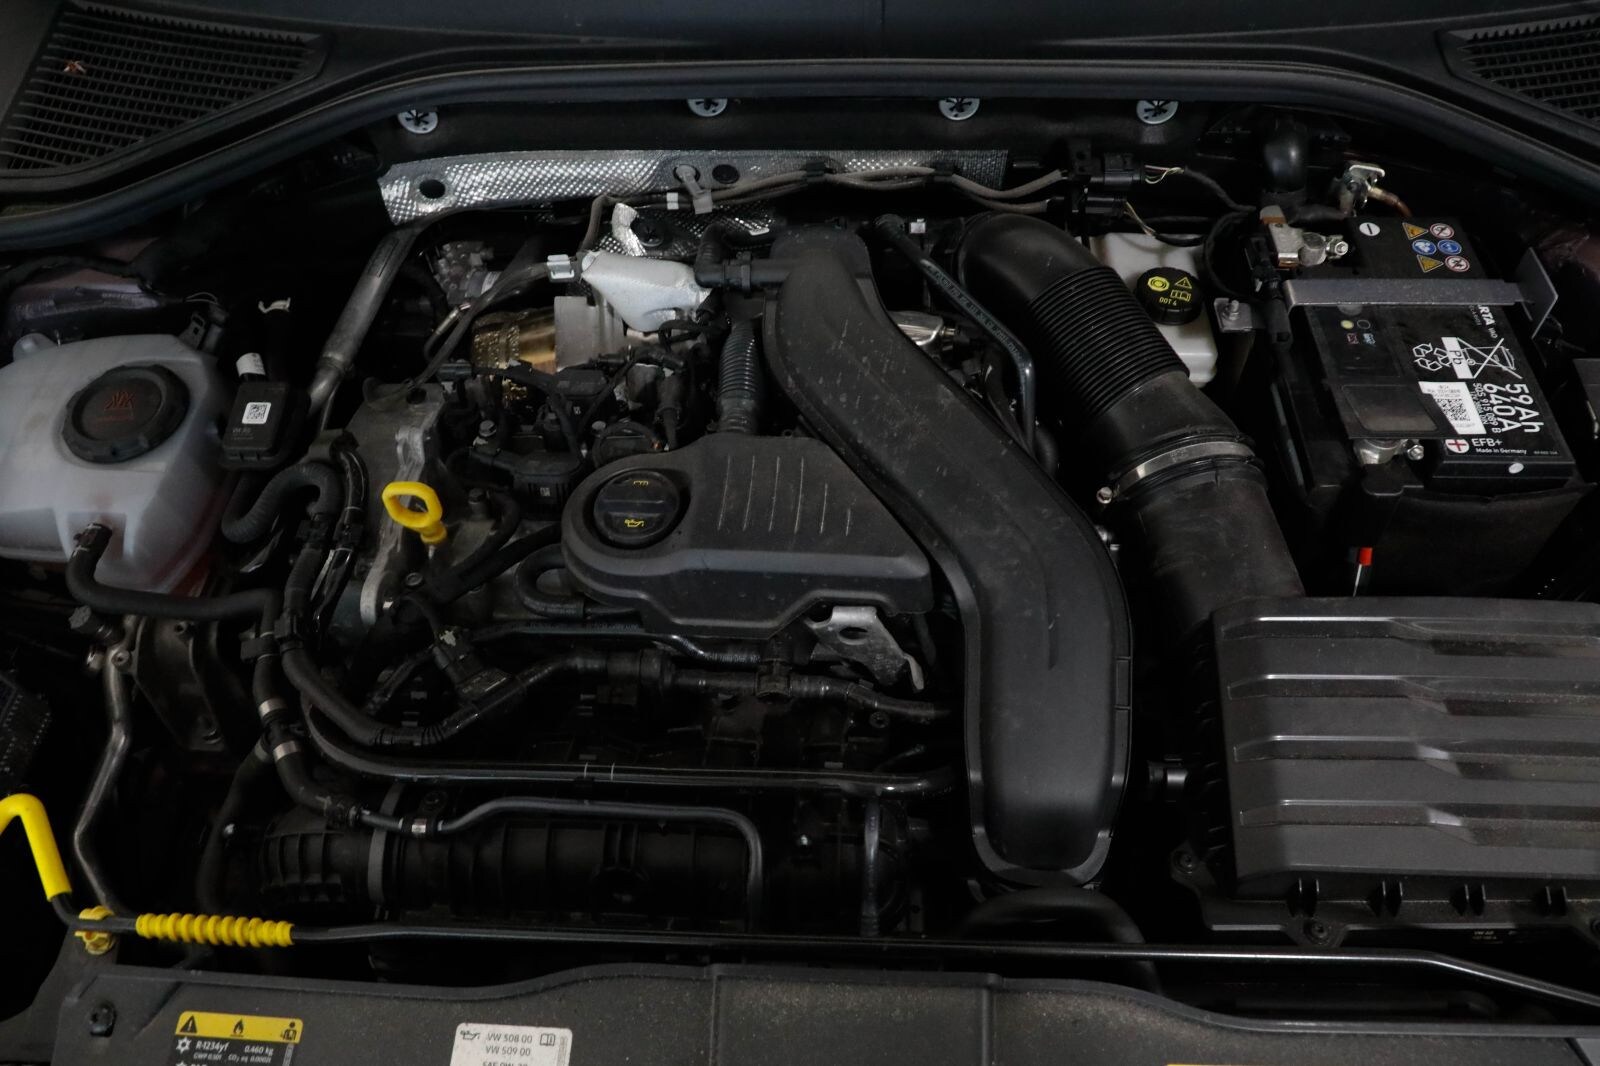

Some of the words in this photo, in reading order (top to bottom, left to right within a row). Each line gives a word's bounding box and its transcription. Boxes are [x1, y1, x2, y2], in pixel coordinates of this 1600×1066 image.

[1159, 296, 1172, 304] DOT
[1477, 304, 1495, 326] RTA
[1449, 350, 1464, 365] Pb
[1483, 383, 1522, 432] 640A
[1505, 383, 1544, 433] 59Ah
[1471, 438, 1503, 447] EFB+
[487, 1032, 501, 1042] VW
[504, 1033, 520, 1043] 508
[521, 1034, 533, 1044] 00
[264, 1047, 274, 1056] kg
[485, 1045, 499, 1055] VW
[502, 1046, 518, 1056] 509
[519, 1047, 531, 1057] 00
